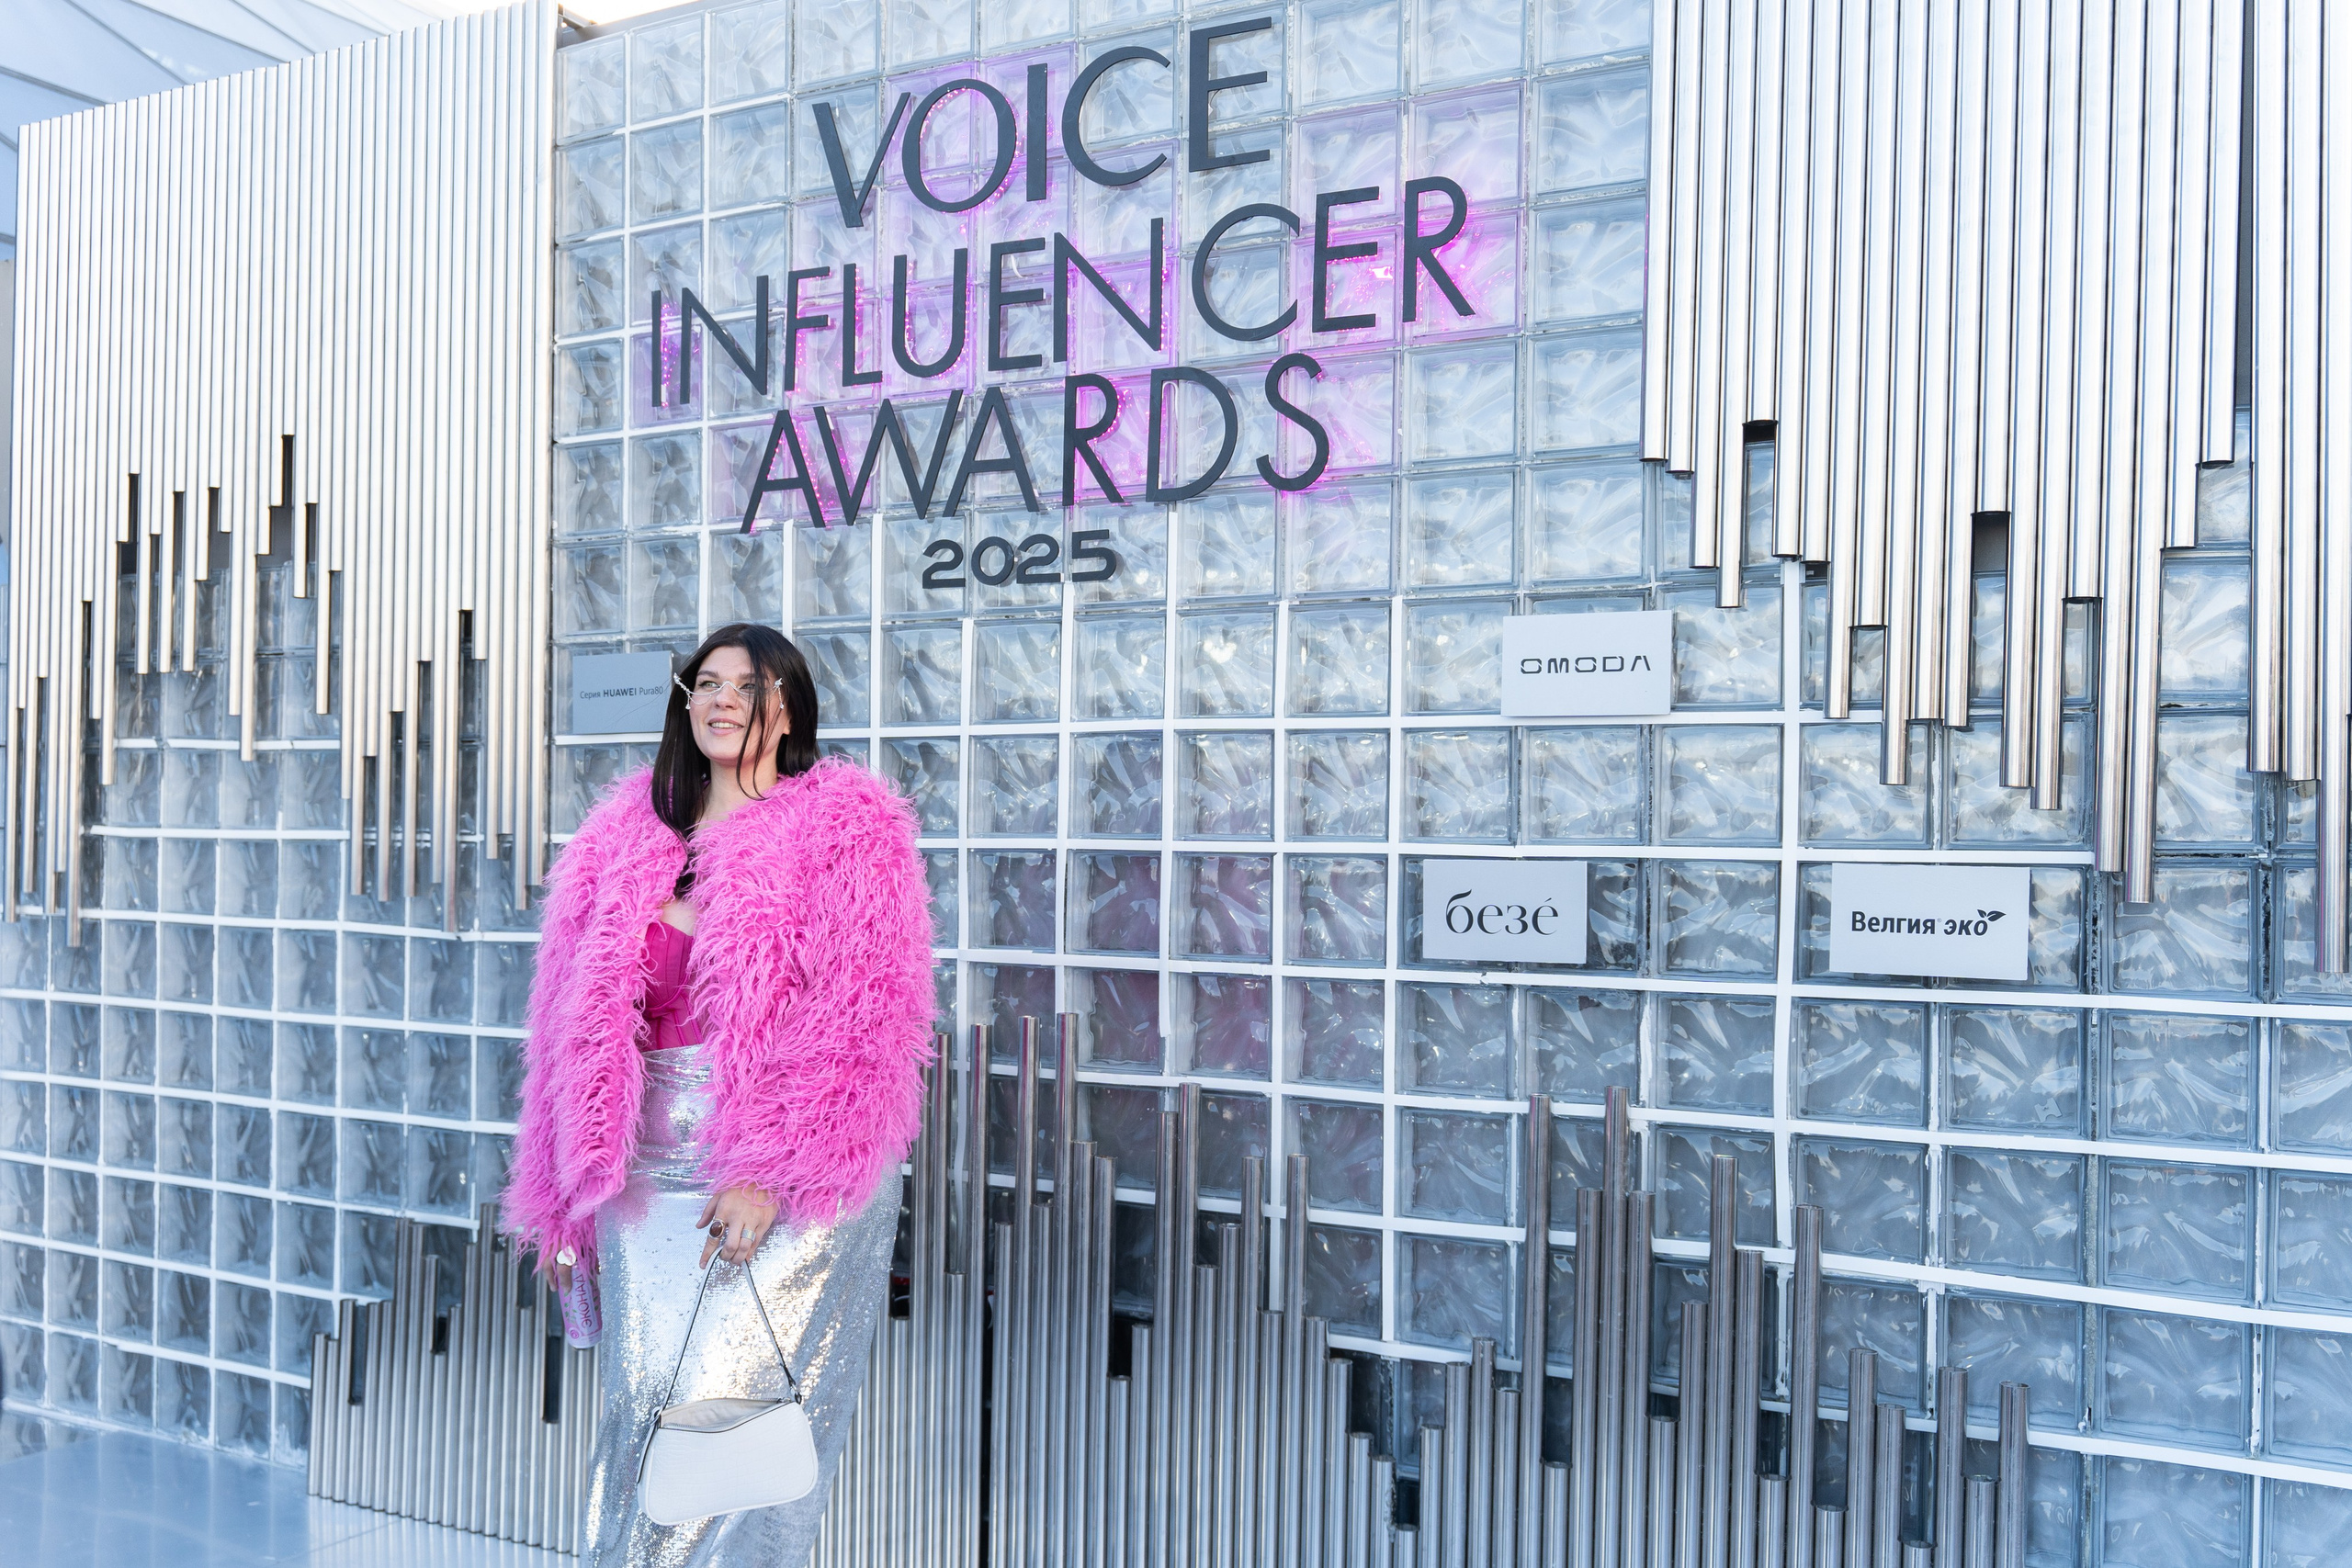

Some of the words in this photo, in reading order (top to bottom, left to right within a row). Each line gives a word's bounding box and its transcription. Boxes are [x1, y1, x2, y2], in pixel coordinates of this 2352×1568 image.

[812, 17, 1272, 228] VOICE
[651, 176, 1476, 407] INFLUENCER
[741, 353, 1329, 534] AWARDS
[922, 529, 1117, 589] 2025
[580, 691, 601, 700] Серия
[603, 687, 637, 697] HUAWEI
[639, 686, 663, 695] Pura80
[1521, 655, 1651, 674] OMODA
[1943, 919, 1988, 936] эко
